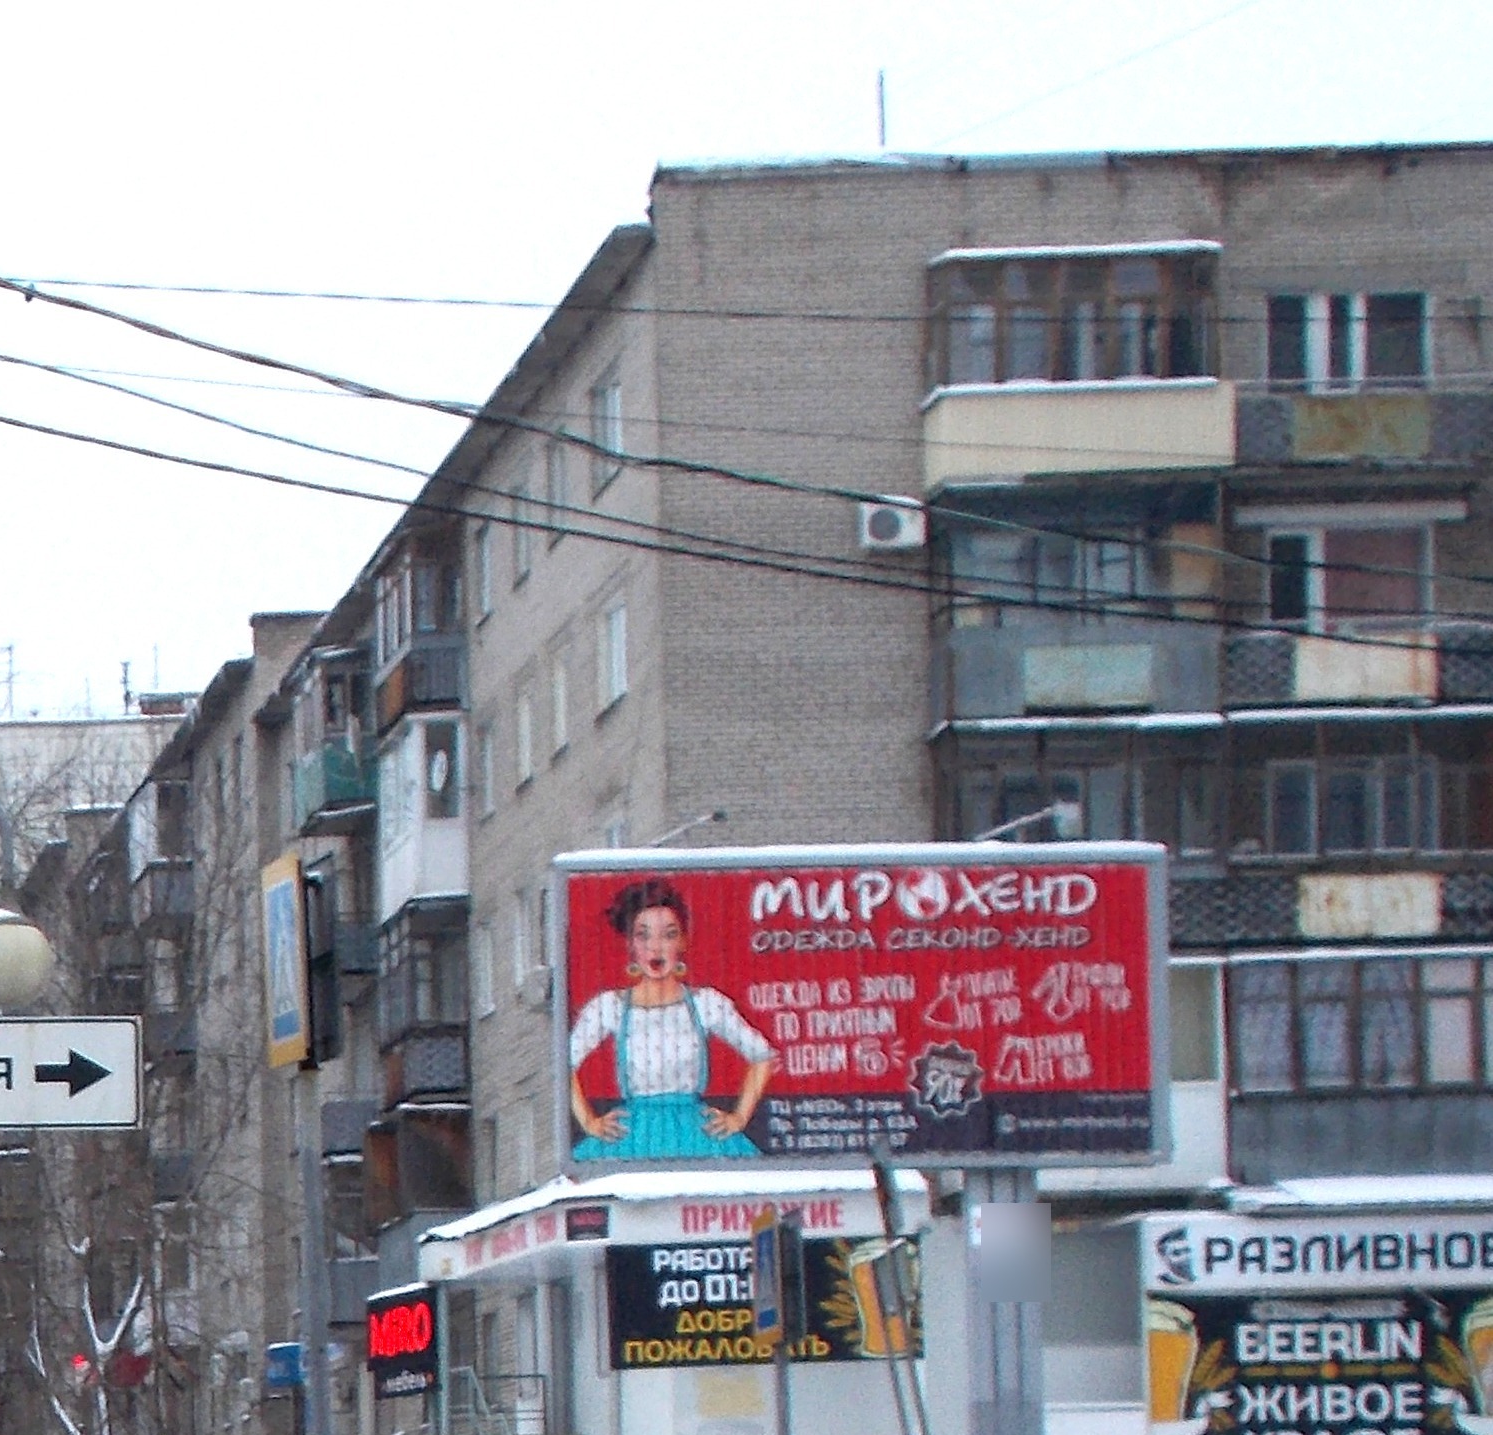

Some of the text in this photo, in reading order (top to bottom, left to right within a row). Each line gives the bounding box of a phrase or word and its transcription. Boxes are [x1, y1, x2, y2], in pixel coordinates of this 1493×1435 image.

[750, 928, 876, 951] ОДЕЖДА
[676, 1309, 754, 1334] ДОБР
[1236, 1320, 1424, 1363] BEERLIN
[1236, 1382, 1426, 1424] ЖИВОЕ
